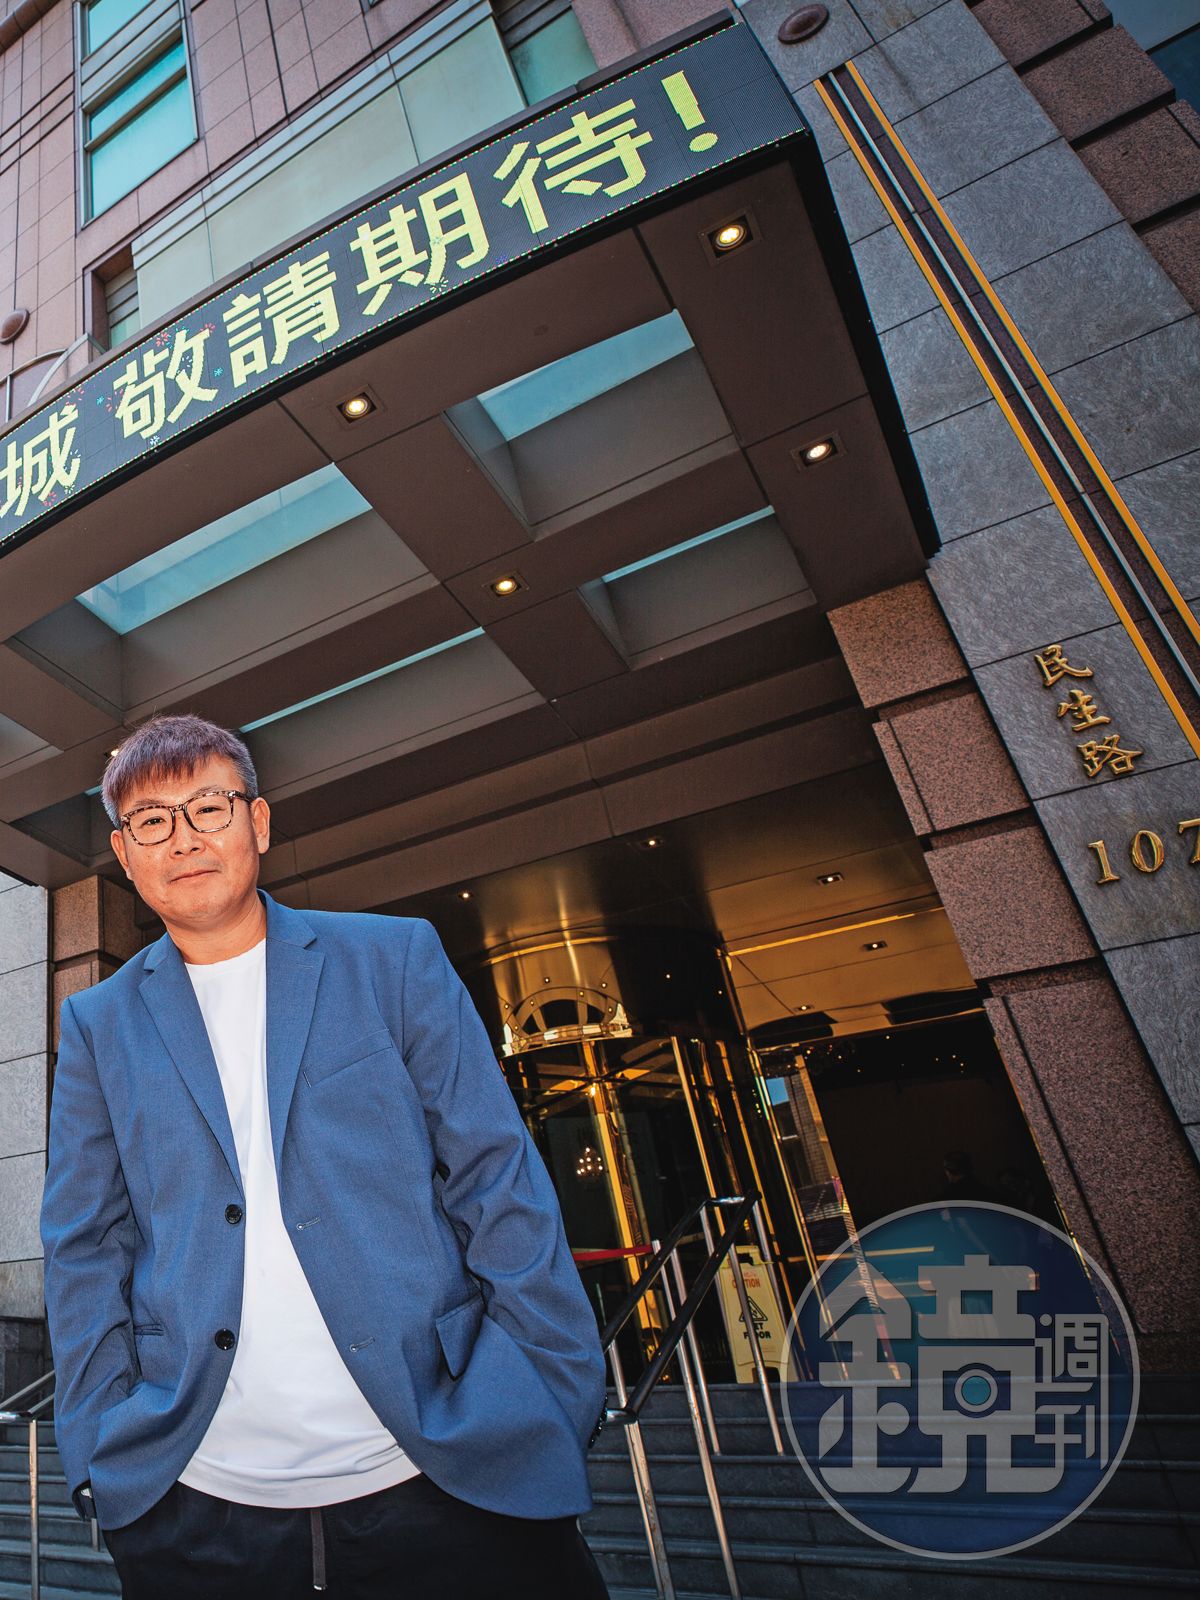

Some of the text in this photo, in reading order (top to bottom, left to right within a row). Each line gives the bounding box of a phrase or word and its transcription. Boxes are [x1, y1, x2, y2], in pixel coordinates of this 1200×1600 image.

[1034, 644, 1143, 778] 民生路
[732, 1278, 761, 1289] CTION
